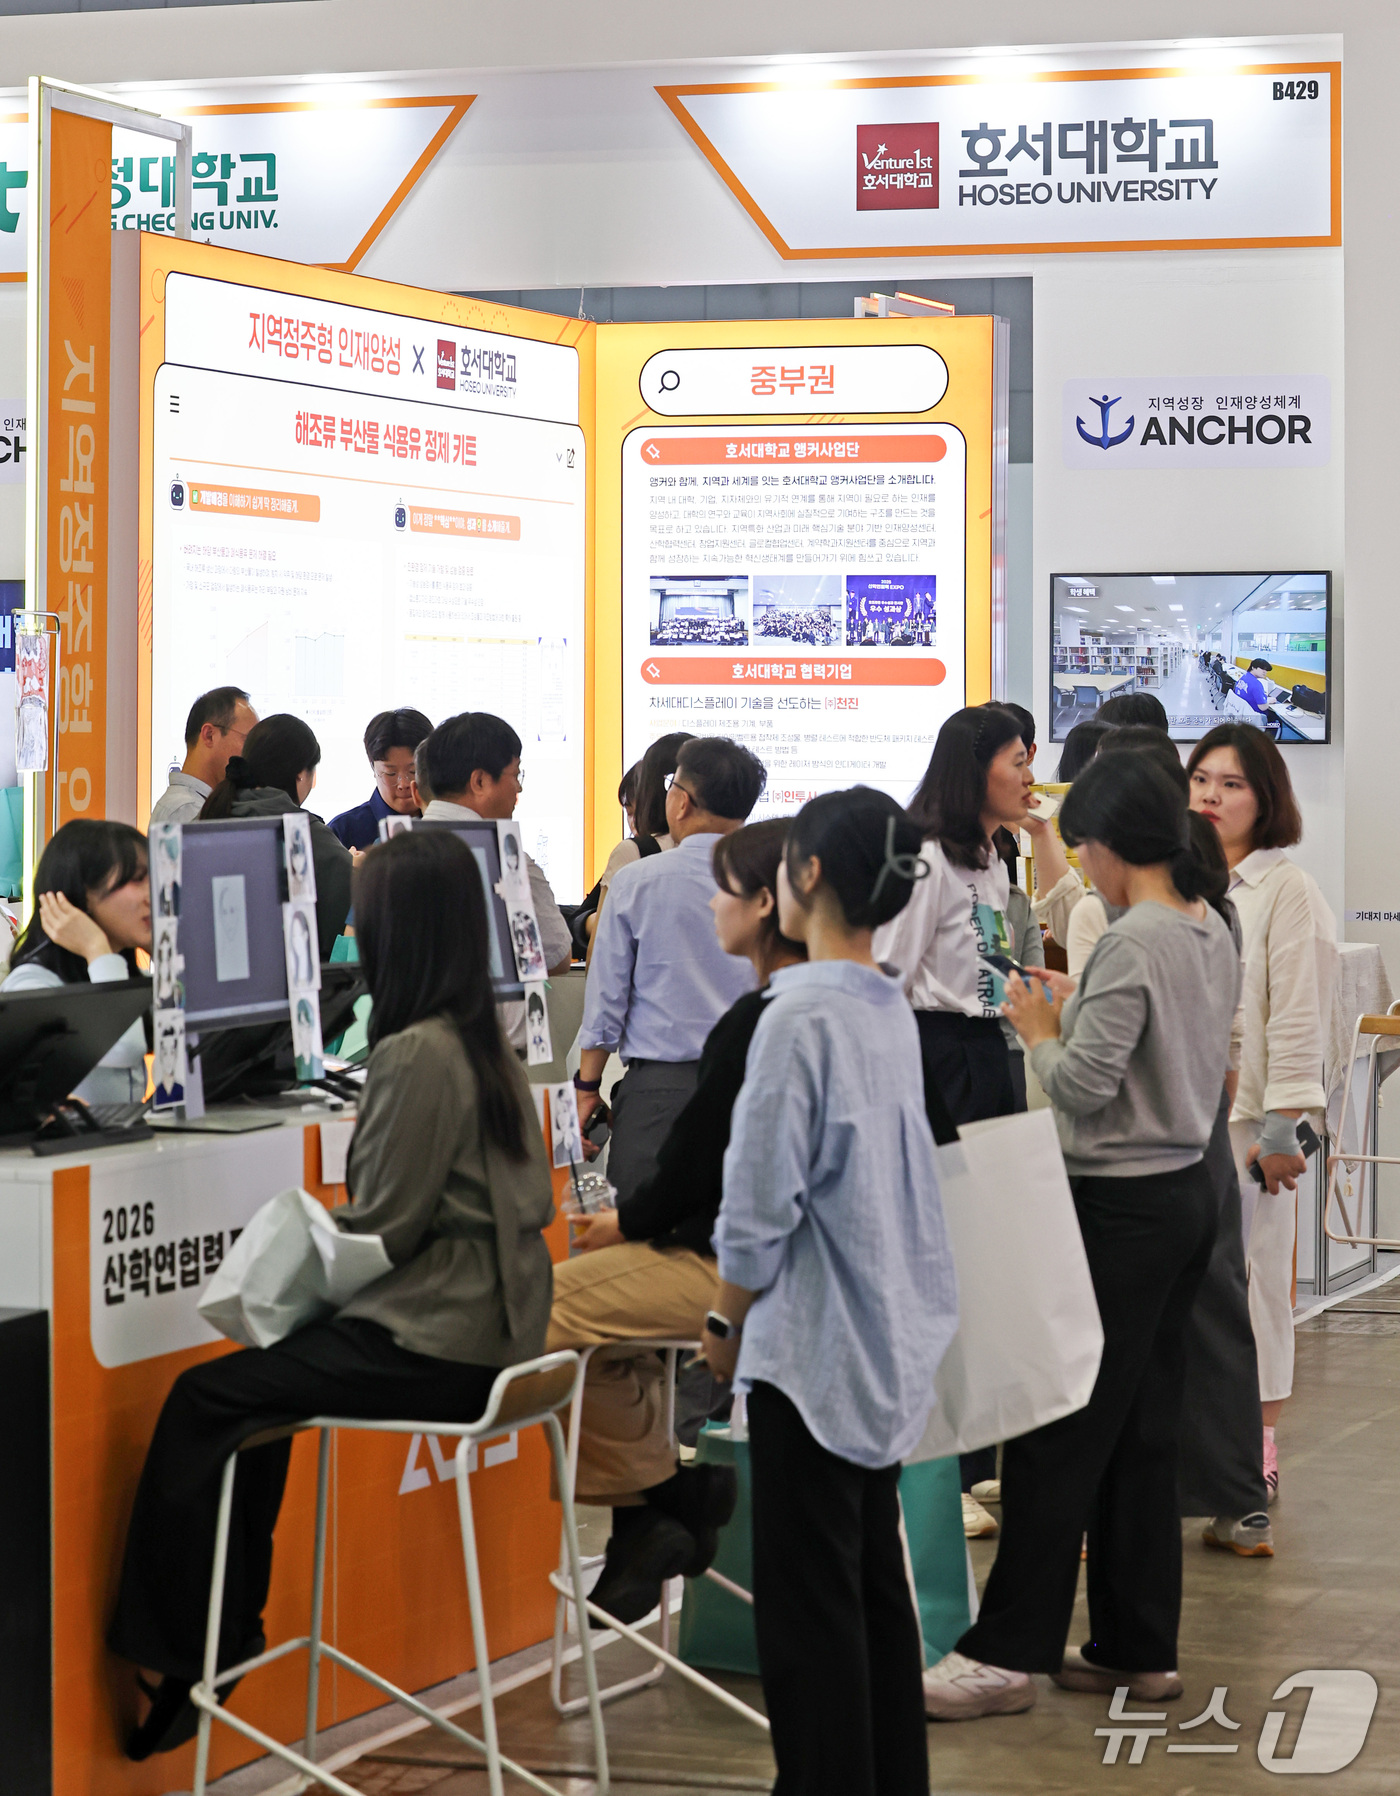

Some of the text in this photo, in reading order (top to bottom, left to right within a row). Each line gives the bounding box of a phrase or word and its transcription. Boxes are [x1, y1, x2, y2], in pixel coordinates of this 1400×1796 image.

[1273, 80, 1318, 100] B429
[959, 117, 1219, 177] 호서대학교
[862, 173, 933, 190] 호서대학교
[959, 178, 1219, 206] HOSEO UNIVERSITY
[219, 209, 279, 230] UNIV.
[248, 312, 333, 365] 지역정주형
[338, 327, 401, 376] 인재양성
[460, 345, 517, 383] 호서대학교
[751, 364, 835, 395] 중부권
[460, 379, 517, 399] HOSEO UNIVERSITY
[1148, 395, 1302, 411] 지역성장 인재양성체계
[295, 410, 477, 466] 해조류 부산물 식용유 정제 키트
[1140, 414, 1312, 446] ANCHOR
[726, 441, 860, 459] 호서대학교 앵커사업단
[650, 477, 676, 487] 앵커와
[703, 477, 729, 486] 지역과
[732, 476, 758, 486] 세계를
[762, 476, 779, 486] 잇는
[783, 475, 827, 486] 호서대학교
[831, 475, 884, 485] 앵커사업단을
[888, 475, 936, 485] 소개합니다.
[650, 496, 666, 504] 지역
[668, 496, 676, 504] 내
[722, 495, 761, 503] 지자체와의
[765, 495, 788, 503] 유기적
[792, 494, 815, 503] 연계를
[819, 494, 834, 503] 통해
[838, 494, 862, 502] 지역이
[865, 494, 889, 504] 필요로
[892, 494, 908, 502] 하는
[911, 494, 936, 502] 인재를
[684, 509, 707, 519] 대학의
[708, 509, 731, 519] 연구와
[733, 509, 755, 518] 교육이
[757, 508, 795, 518] 지역사회에
[798, 509, 835, 518] 실질적으로
[838, 509, 867, 518] 기여하는
[870, 509, 892, 518] 구조를
[895, 509, 917, 517] 만드는
[921, 508, 936, 517] 것을
[59, 338, 97, 734] 지역정주형
[650, 525, 673, 534] 목표로
[676, 525, 691, 533] 하고
[695, 525, 728, 534] 있습니다.
[732, 524, 764, 533] 지역특화
[767, 524, 790, 533] 산업과
[793, 524, 809, 532] 미래
[812, 524, 844, 533] 핵심기술
[847, 524, 863, 533] 분야
[867, 524, 882, 532] 기반
[808, 539, 876, 548] 계약학과지원센터를
[879, 539, 909, 547] 중심으로
[912, 538, 936, 547] 지역과
[650, 554, 666, 563] 함께
[669, 554, 699, 563] 성장하는
[703, 554, 742, 563] 지속가능한
[745, 553, 793, 564] 혁신생태계를
[796, 554, 836, 563] 만들어가기
[859, 554, 882, 562] 힘쓰고
[886, 553, 920, 563] 있습니다.
[732, 663, 853, 680] 호서대학교 협력기업
[649, 697, 738, 710] 차세대디스플레이
[741, 697, 774, 710] 기술을
[777, 697, 822, 710] 선도하는
[682, 719, 717, 728] 디스플레이
[719, 719, 740, 728] 제조용
[1356, 911, 1382, 922] 기대지
[104, 1201, 155, 1245] 2026
